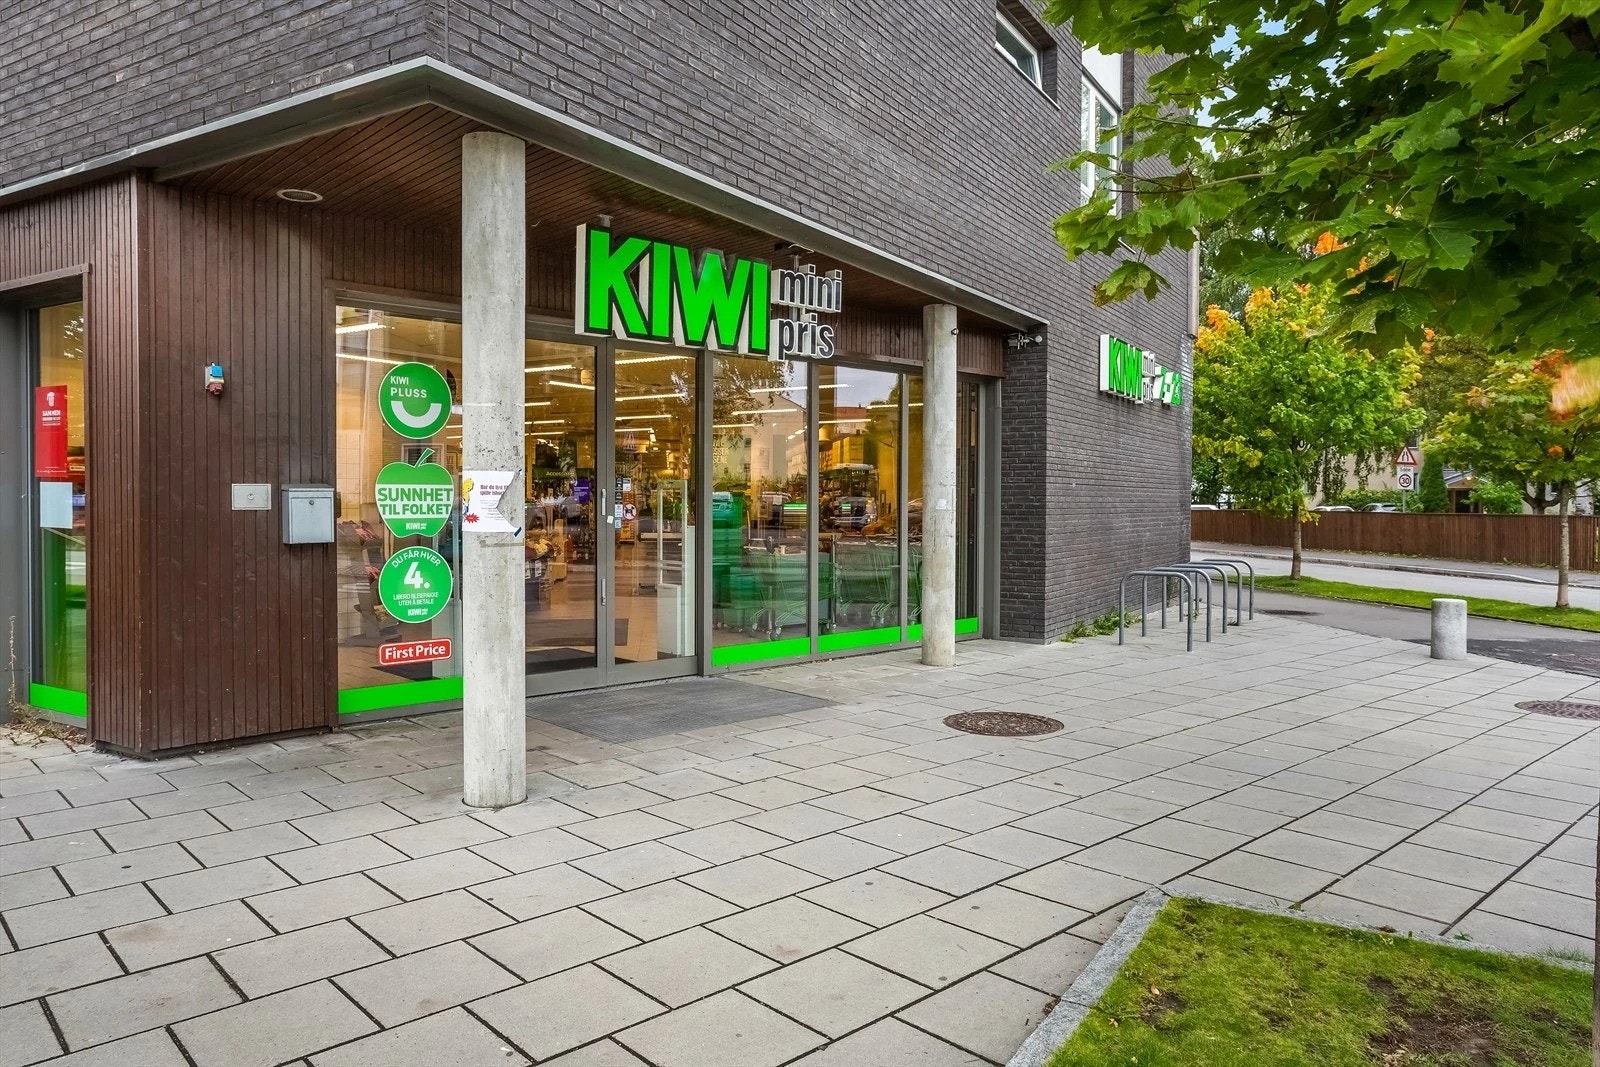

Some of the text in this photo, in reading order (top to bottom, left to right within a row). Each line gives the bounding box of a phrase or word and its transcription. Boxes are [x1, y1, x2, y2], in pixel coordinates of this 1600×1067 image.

[586, 226, 842, 354] KIWI mini
[776, 314, 834, 362] pris
[1108, 335, 1143, 401] KIWI
[390, 375, 409, 385] KIWI
[390, 387, 427, 398] PLUSS
[1401, 477, 1410, 485] 30
[377, 487, 453, 502] SUNNHET
[380, 503, 451, 515] TIL FOLKET
[405, 522, 421, 530] KIWI
[391, 550, 441, 568] DU FÅR HVER
[403, 561, 430, 589] 4.
[385, 643, 446, 660] First Price
